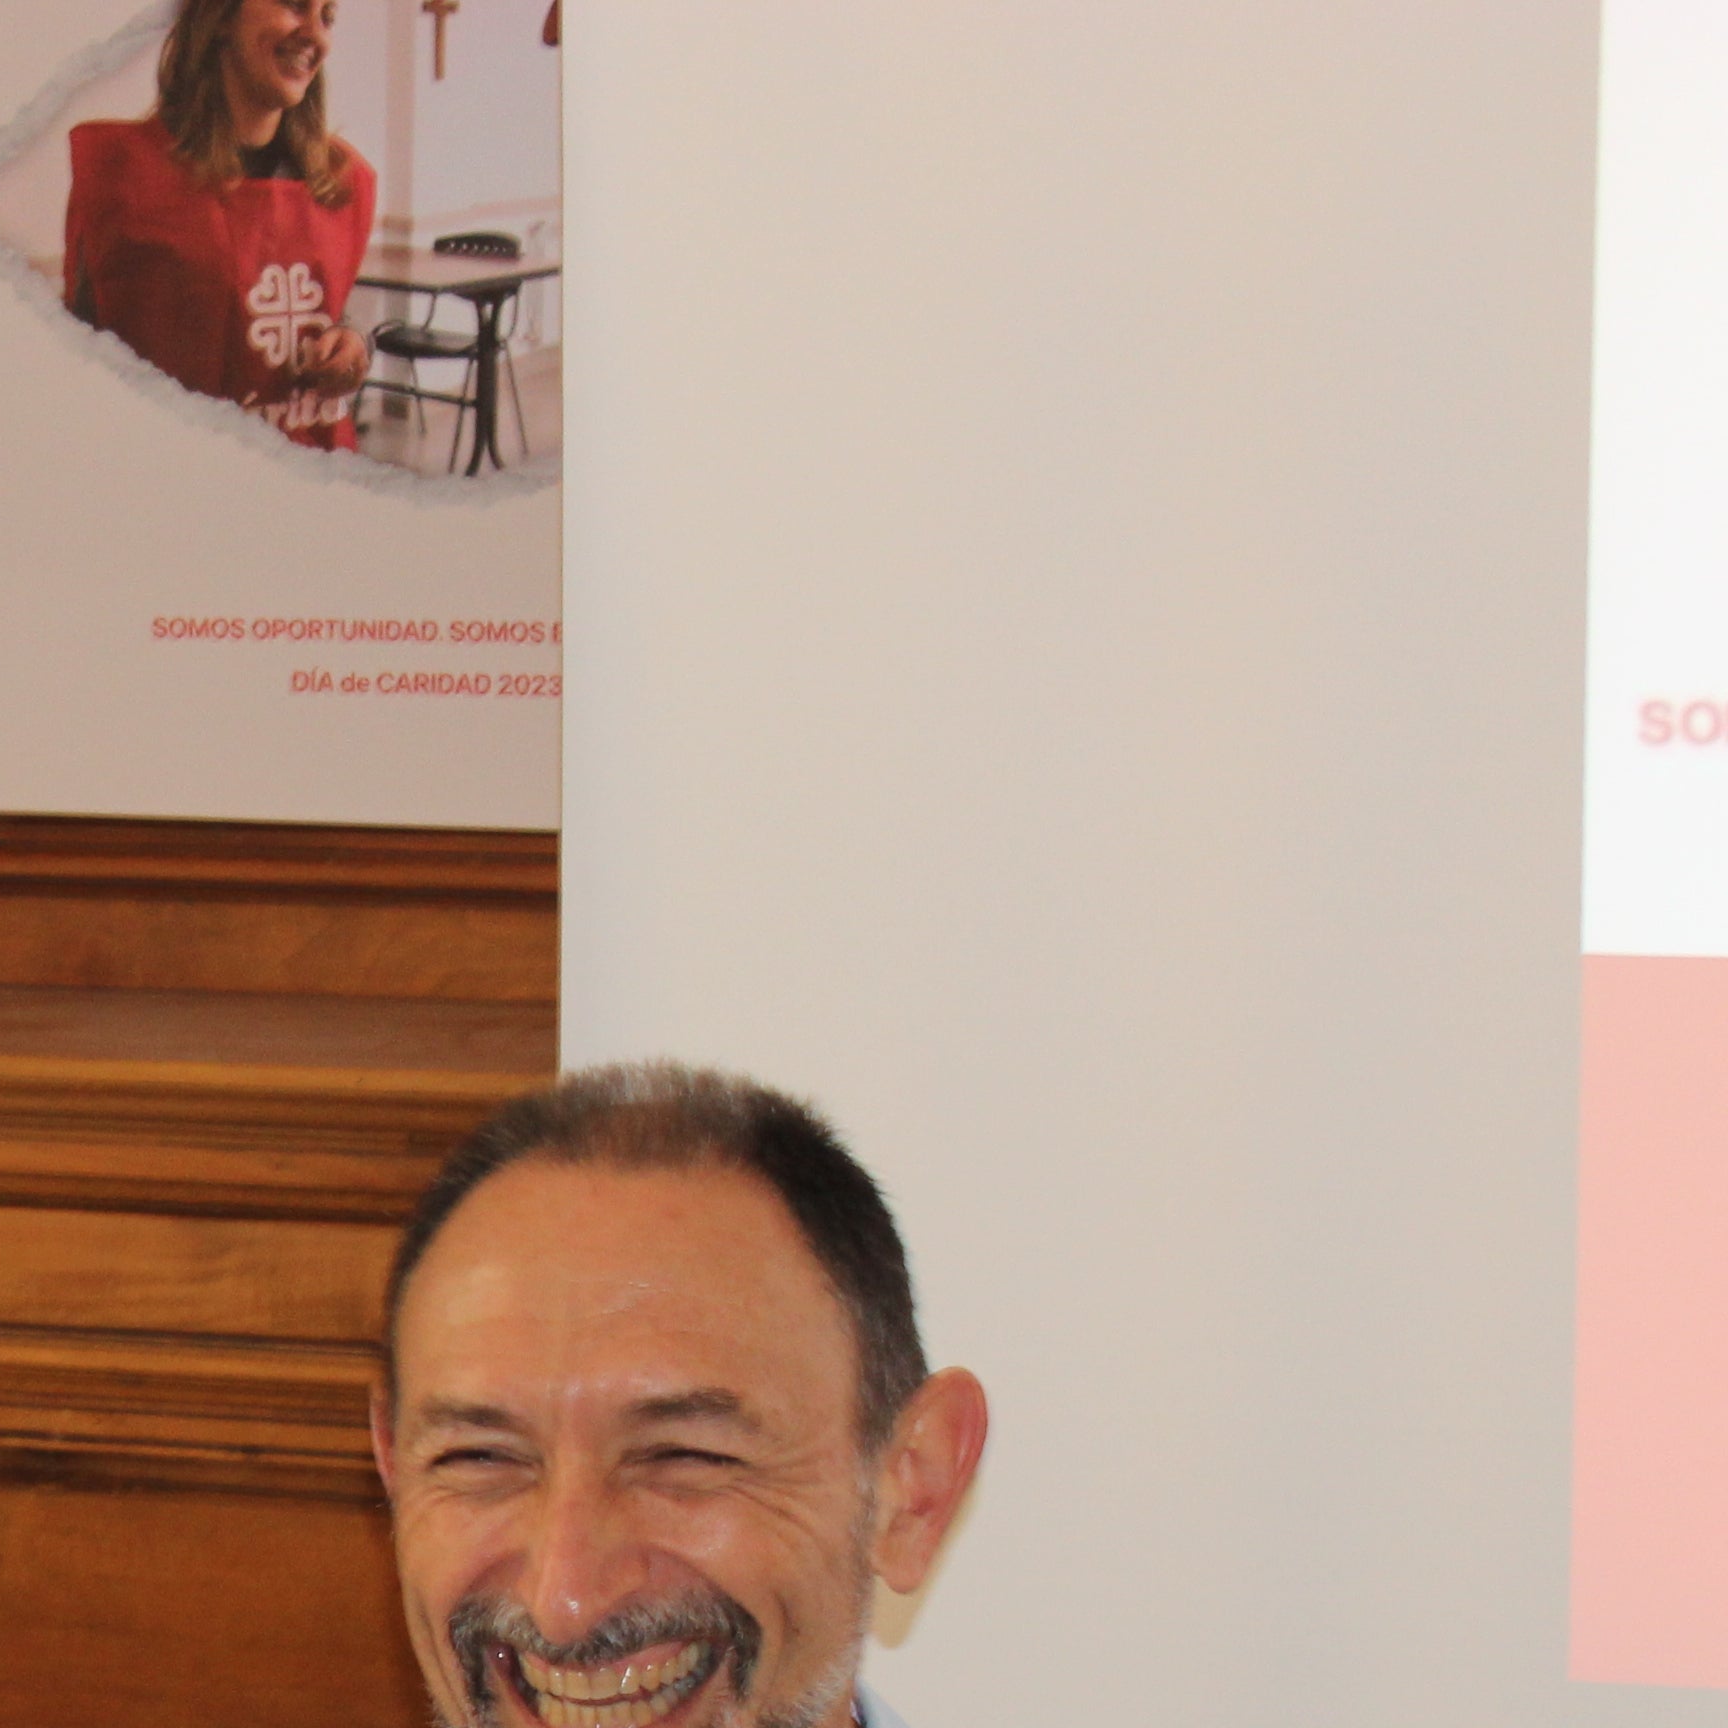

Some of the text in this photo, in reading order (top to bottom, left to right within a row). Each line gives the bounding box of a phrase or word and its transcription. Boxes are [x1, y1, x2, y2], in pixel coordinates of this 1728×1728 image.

[152, 617, 246, 640] SOMOS
[251, 617, 443, 643] OPORTUNIDAD.
[449, 619, 546, 644] SOMOS
[290, 666, 562, 698] DÍA de CARIDAD 2023
[1638, 698, 1728, 747] SO
